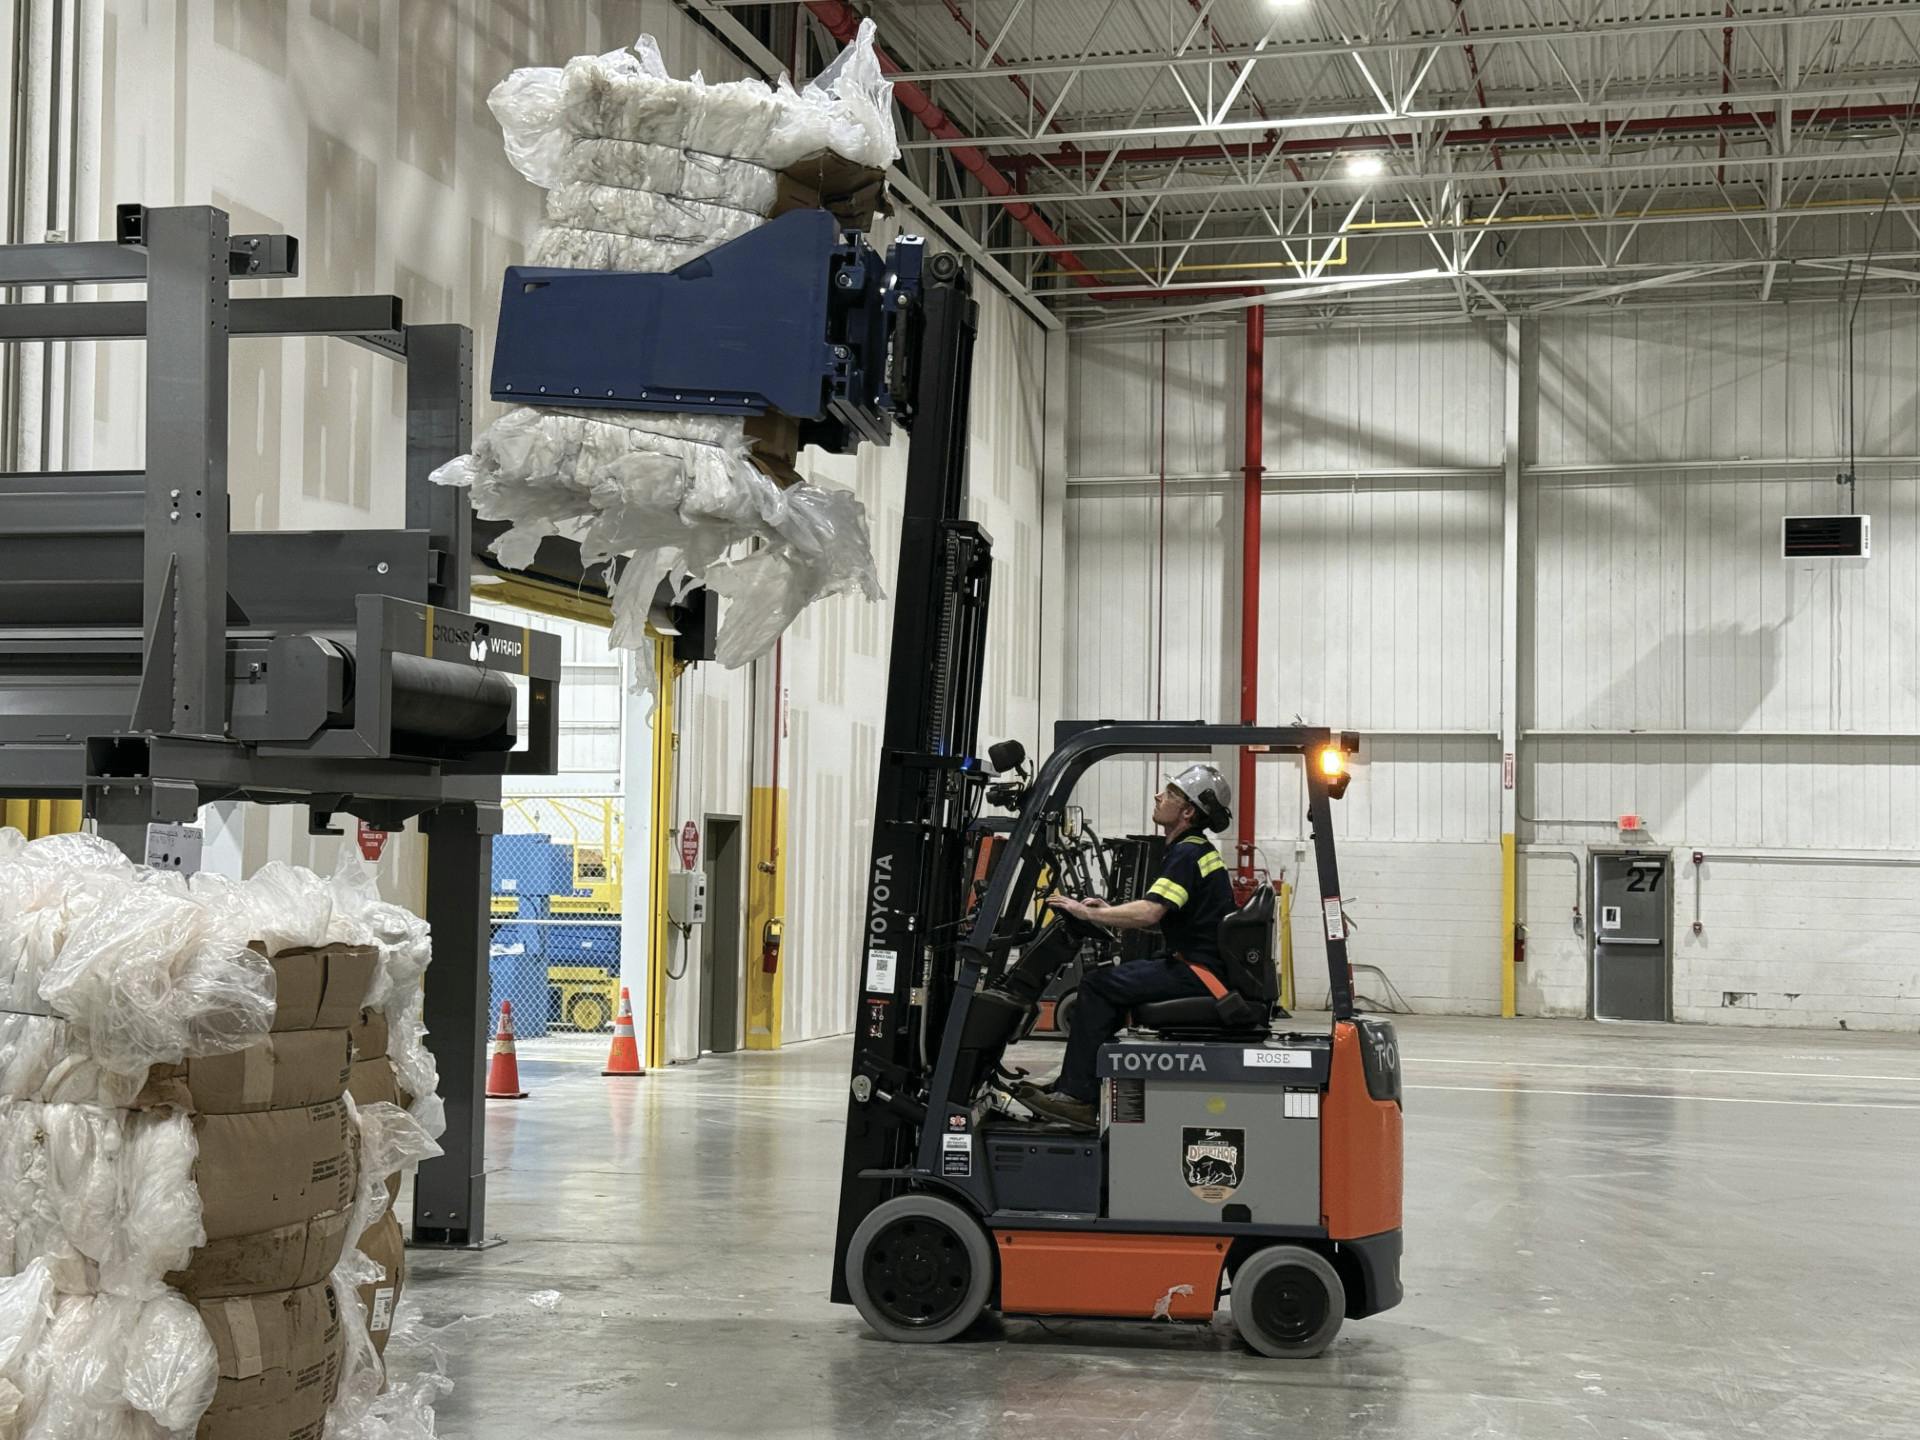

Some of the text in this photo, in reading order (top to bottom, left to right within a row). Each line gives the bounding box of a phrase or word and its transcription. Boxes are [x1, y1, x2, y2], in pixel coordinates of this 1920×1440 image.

[432, 624, 522, 657] CROSS WRAP
[1626, 866, 1665, 892] 27
[868, 854, 893, 948] TOYOTA
[1108, 1053, 1207, 1072] TOYOTA
[1256, 1053, 1291, 1064] ROSE
